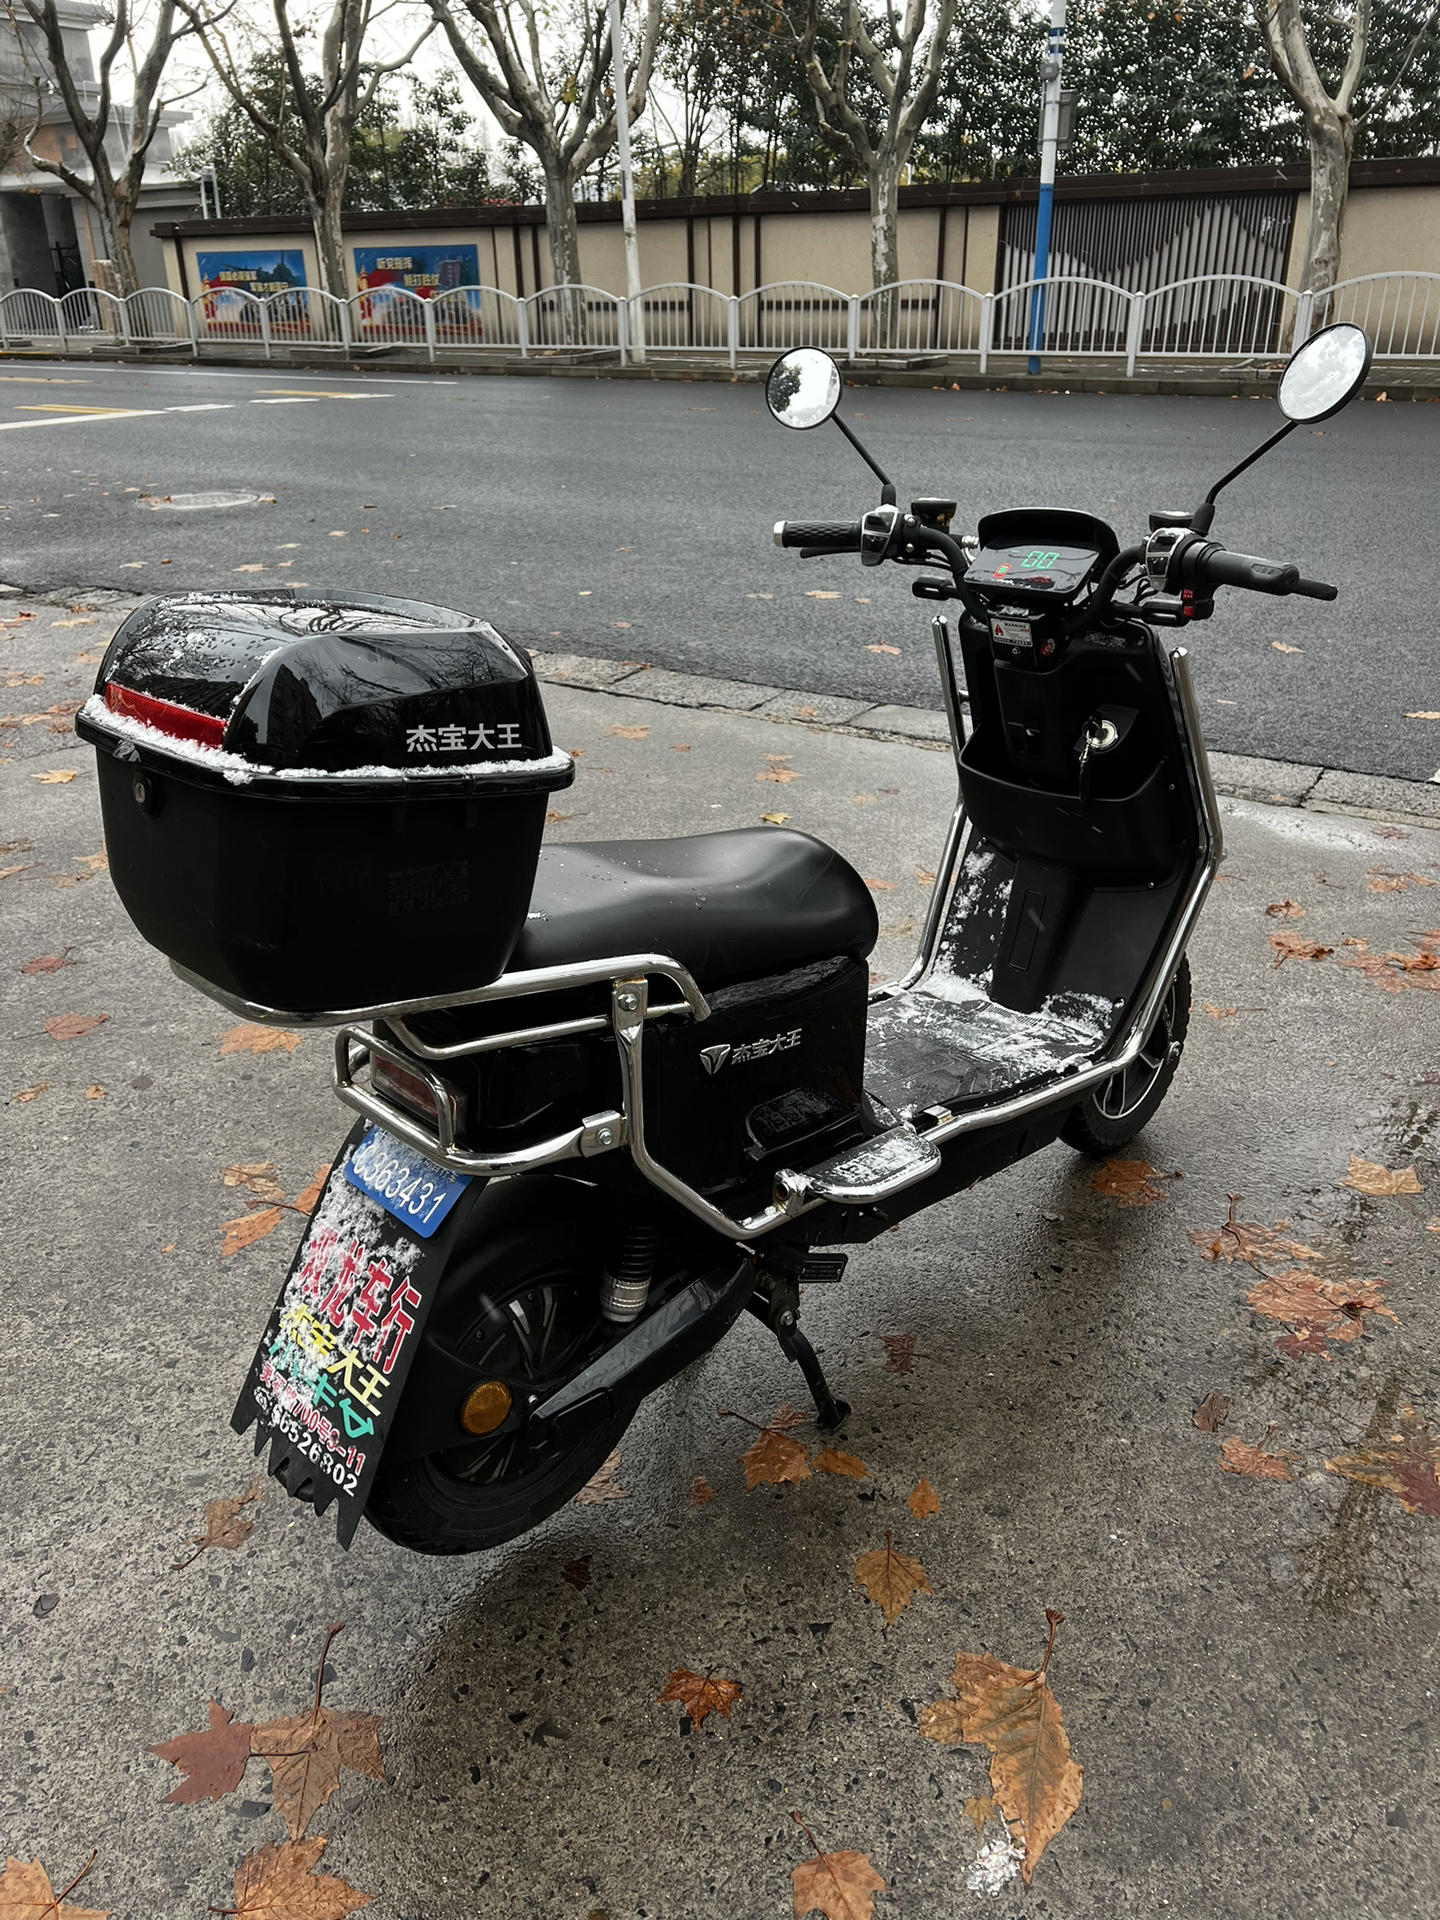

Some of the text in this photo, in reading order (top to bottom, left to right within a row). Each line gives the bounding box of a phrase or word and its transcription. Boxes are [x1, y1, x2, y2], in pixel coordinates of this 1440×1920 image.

[1021, 550, 1059, 569] 00
[406, 723, 522, 753] 杰宝大王
[731, 1028, 802, 1066] 杰宝大王
